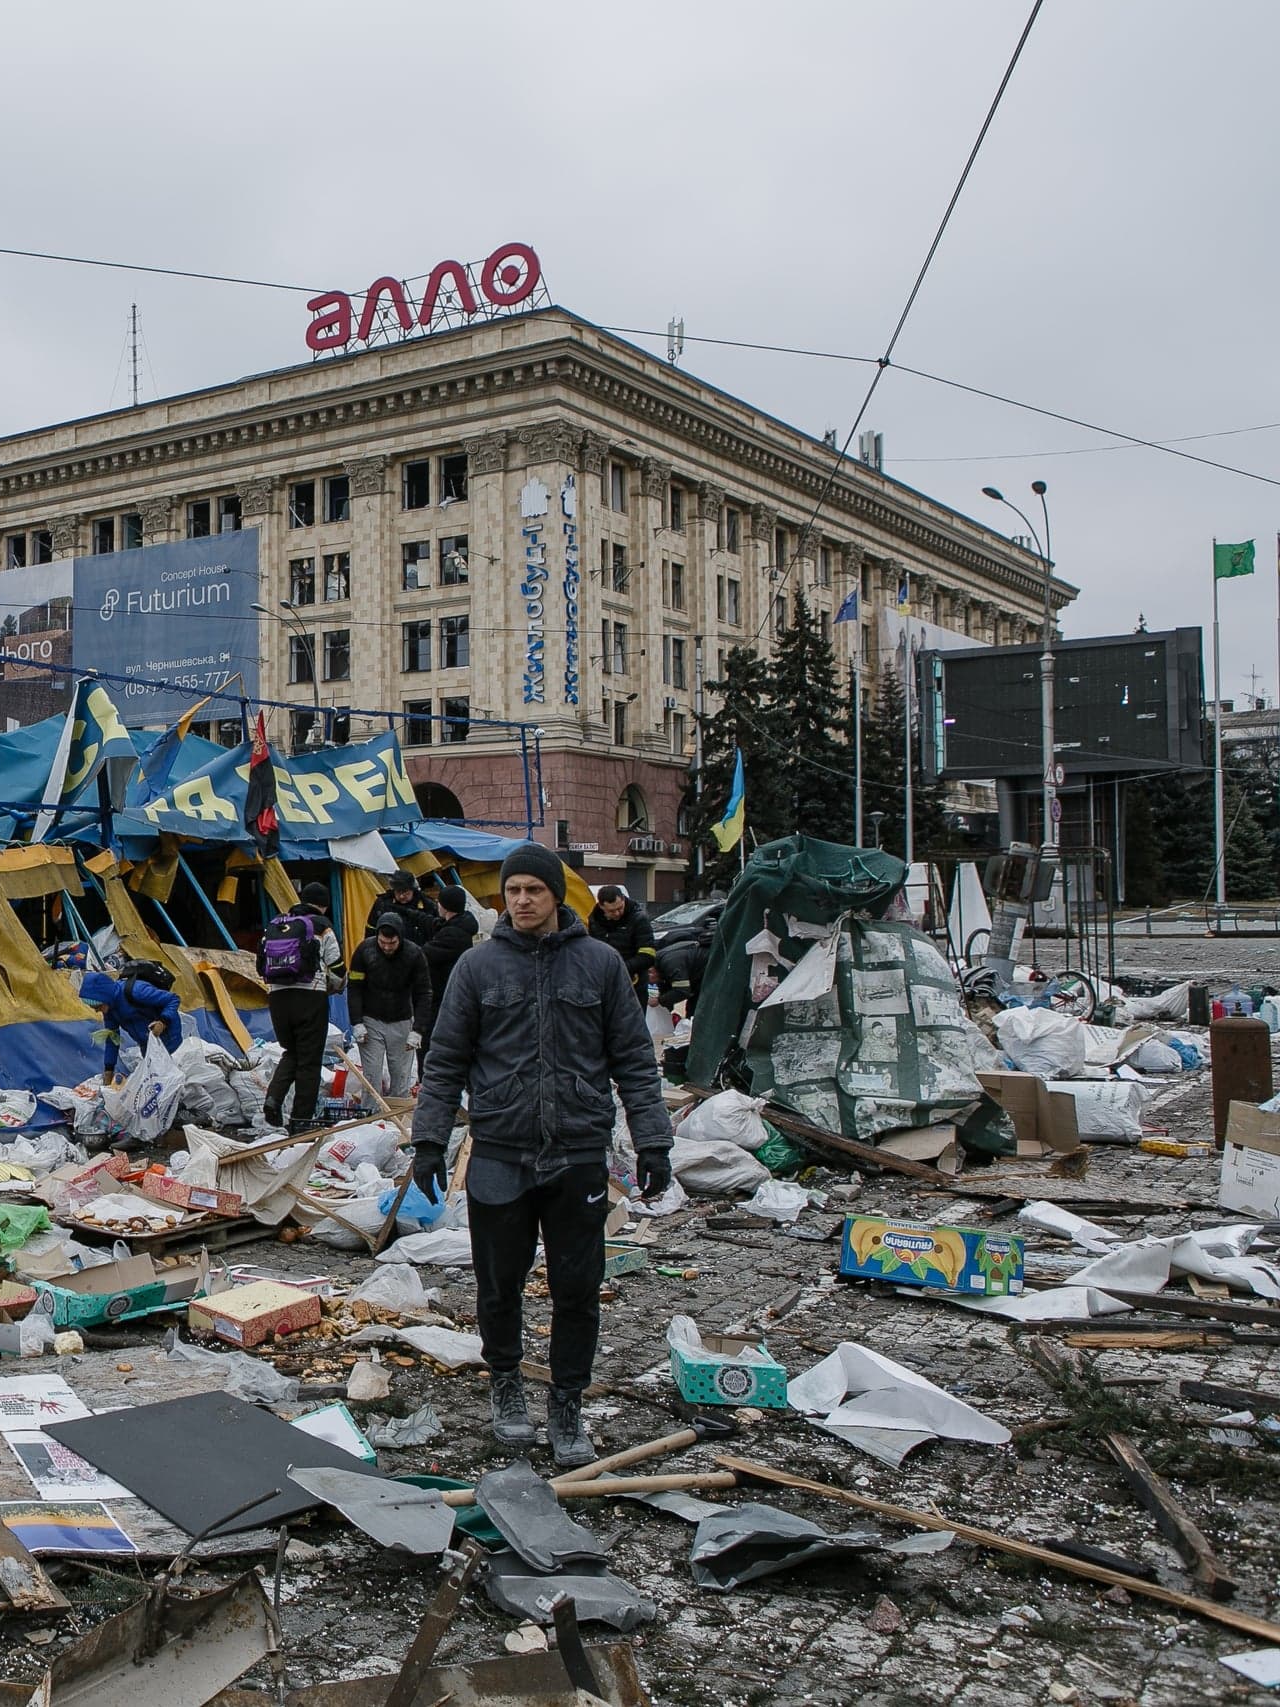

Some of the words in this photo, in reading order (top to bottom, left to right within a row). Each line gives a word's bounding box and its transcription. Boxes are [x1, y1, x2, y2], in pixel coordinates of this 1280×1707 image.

[160, 566, 198, 583] Concept
[199, 563, 228, 576] House
[126, 582, 231, 616] Futurium
[125, 664, 145, 676] вул.
[145, 654, 218, 672] Чернишевська,
[885, 1234, 934, 1250] FRUTIBANA
